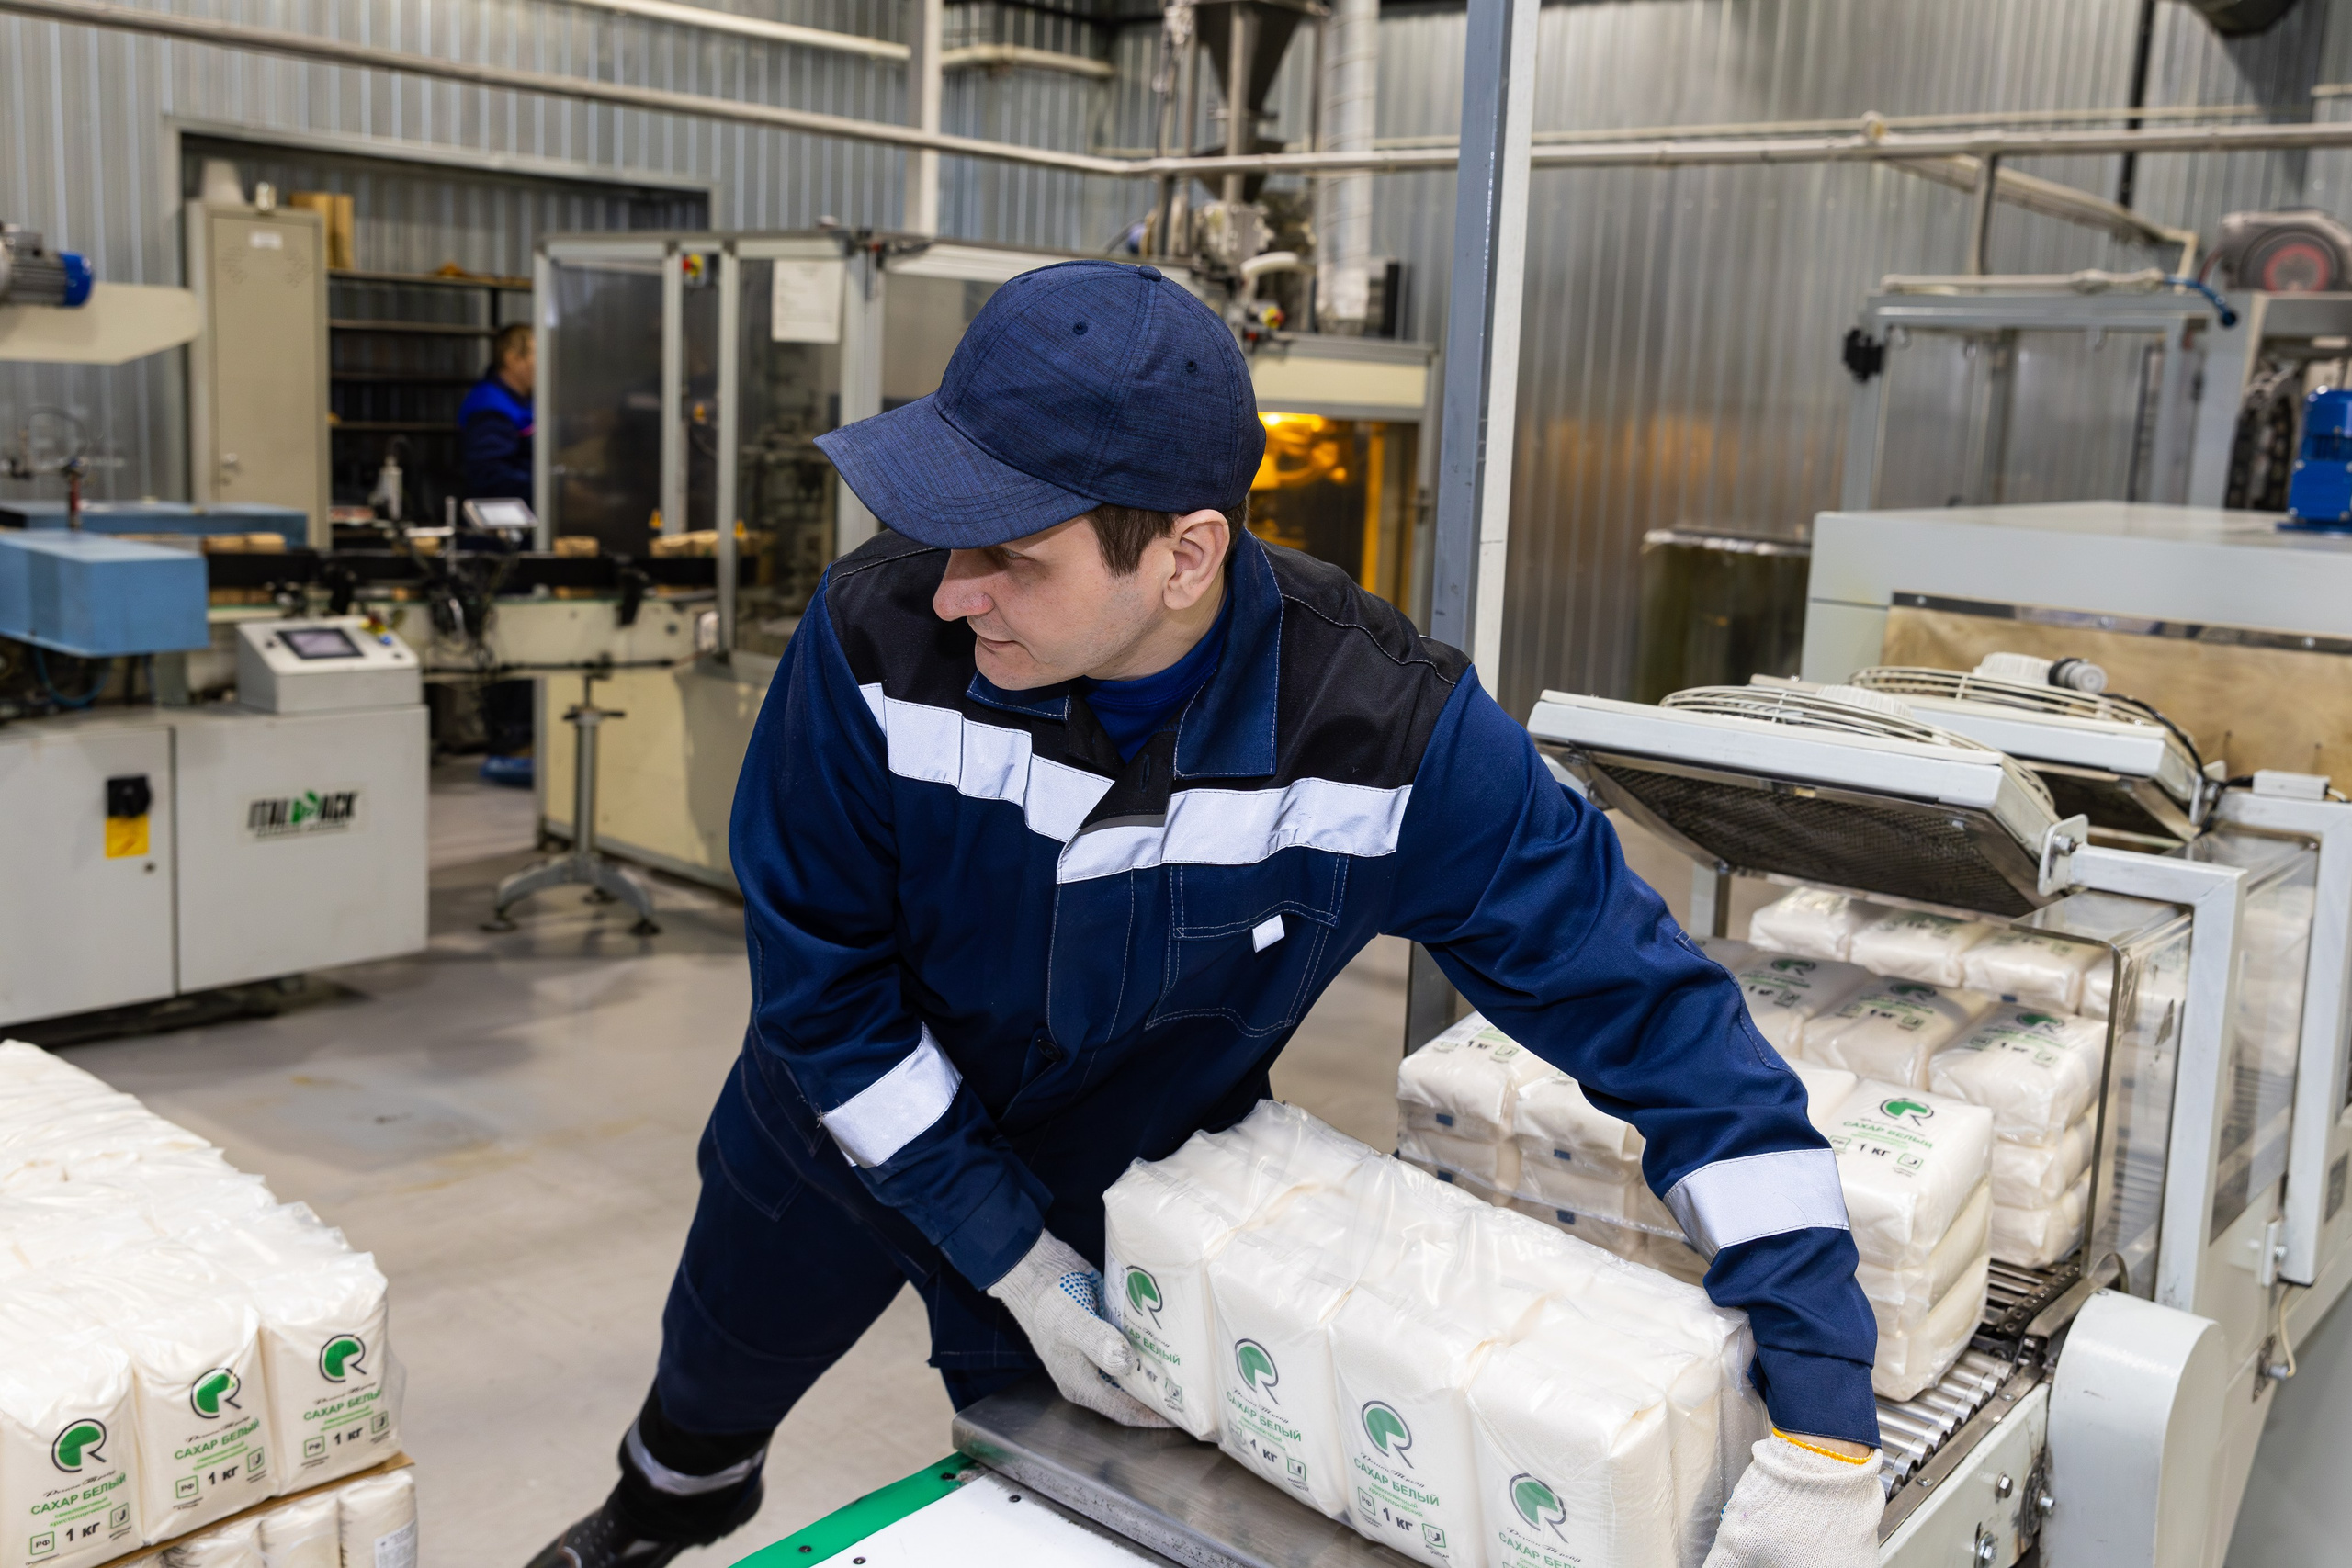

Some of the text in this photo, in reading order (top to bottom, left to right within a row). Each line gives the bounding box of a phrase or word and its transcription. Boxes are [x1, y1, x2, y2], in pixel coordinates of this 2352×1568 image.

[1842, 1121, 1885, 1132] САХАР
[1859, 1143, 1891, 1156] 1 кг
[303, 1402, 345, 1421] САХАР
[1226, 1391, 1257, 1420] САХАР
[1259, 1416, 1303, 1443] БЕЛЫЙ
[175, 1438, 219, 1461] САХАР
[221, 1418, 260, 1447] БЕЛЫЙ
[334, 1432, 342, 1446] 1
[1262, 1448, 1278, 1464] кг
[208, 1471, 216, 1485] 1
[222, 1465, 240, 1482] кг
[1353, 1457, 1440, 1507] САХАР БЕЛЫЙ
[30, 1472, 127, 1516] САХАР БЕЛЫЙ
[1361, 1495, 1373, 1508] РФ
[1382, 1506, 1391, 1522] 1
[1396, 1517, 1414, 1532] кг
[65, 1527, 74, 1542] 1
[82, 1522, 101, 1539] кг
[35, 1539, 51, 1549] РФ
[1498, 1531, 1541, 1560] САХАР
